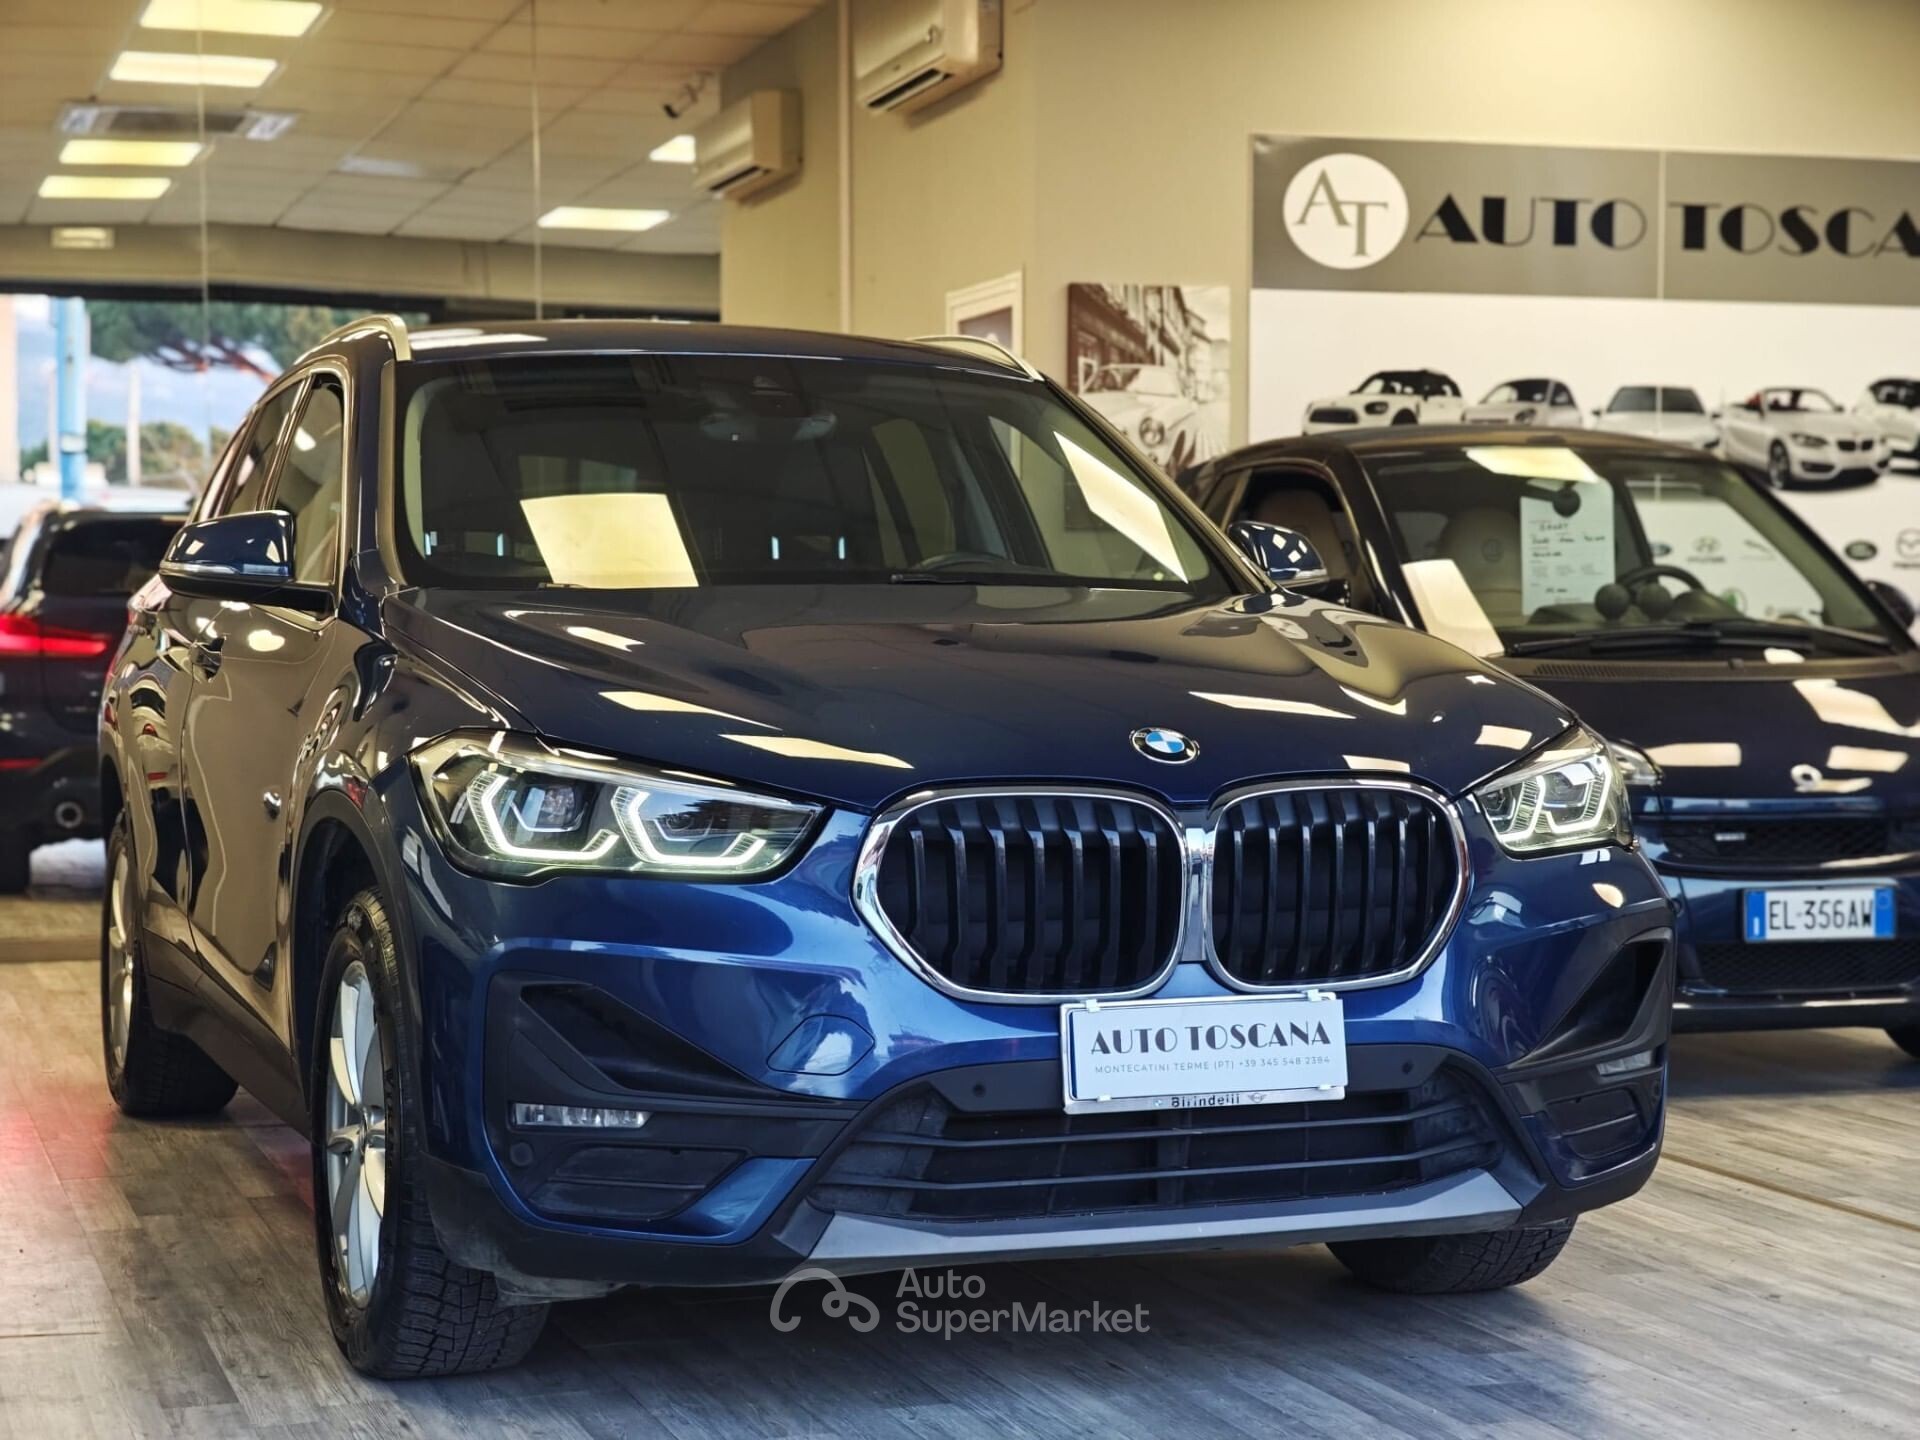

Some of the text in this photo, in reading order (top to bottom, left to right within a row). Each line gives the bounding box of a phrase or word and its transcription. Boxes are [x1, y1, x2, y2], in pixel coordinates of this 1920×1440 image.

[1414, 193, 1648, 251] AUTO
[1091, 1020, 1331, 1055] AUTO TOSCANA
[1095, 1062, 1169, 1074] MONTECATINI
[1174, 1061, 1209, 1071] TERME
